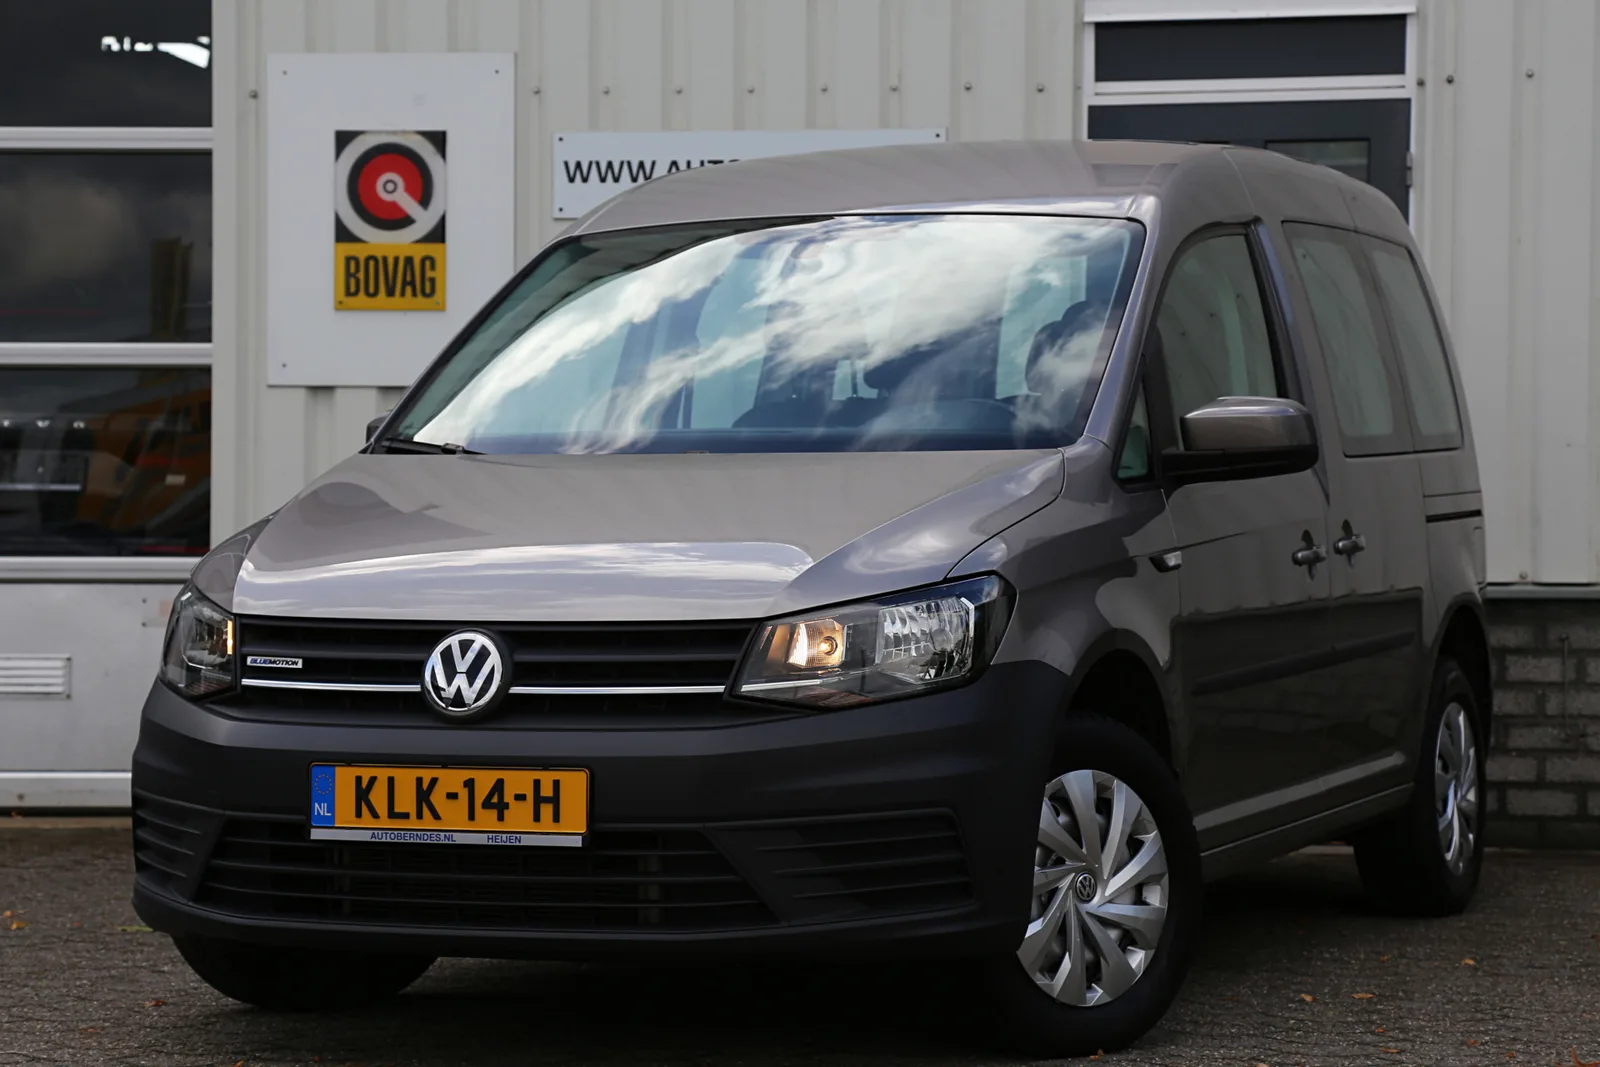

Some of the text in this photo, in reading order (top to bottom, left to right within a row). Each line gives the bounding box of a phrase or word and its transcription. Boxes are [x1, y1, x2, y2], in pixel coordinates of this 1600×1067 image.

[344, 255, 436, 298] BOVAG
[250, 657, 299, 667] BLUEMOTION
[354, 775, 561, 824] KLK-14-H
[314, 802, 332, 816] NL
[370, 831, 522, 845] AUTOBERNDES.NL HEIJEN
